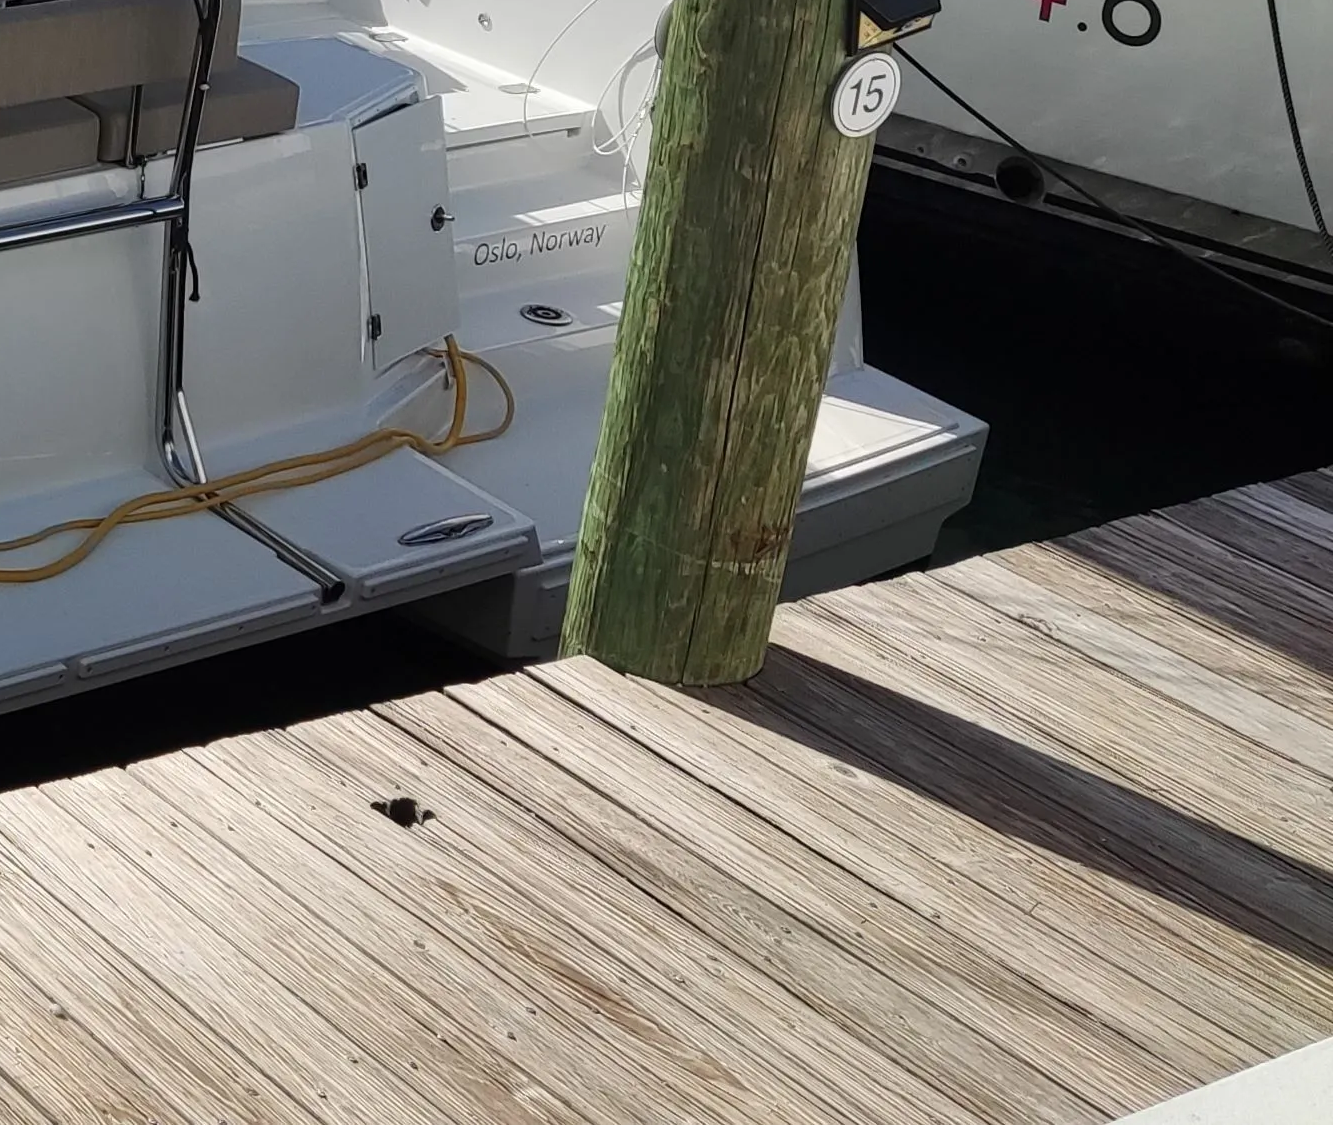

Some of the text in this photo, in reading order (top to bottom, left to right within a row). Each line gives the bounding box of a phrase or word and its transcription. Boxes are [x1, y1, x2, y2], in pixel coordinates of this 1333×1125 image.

[849, 74, 887, 116] 15
[474, 225, 606, 266] Oslo, Norway
